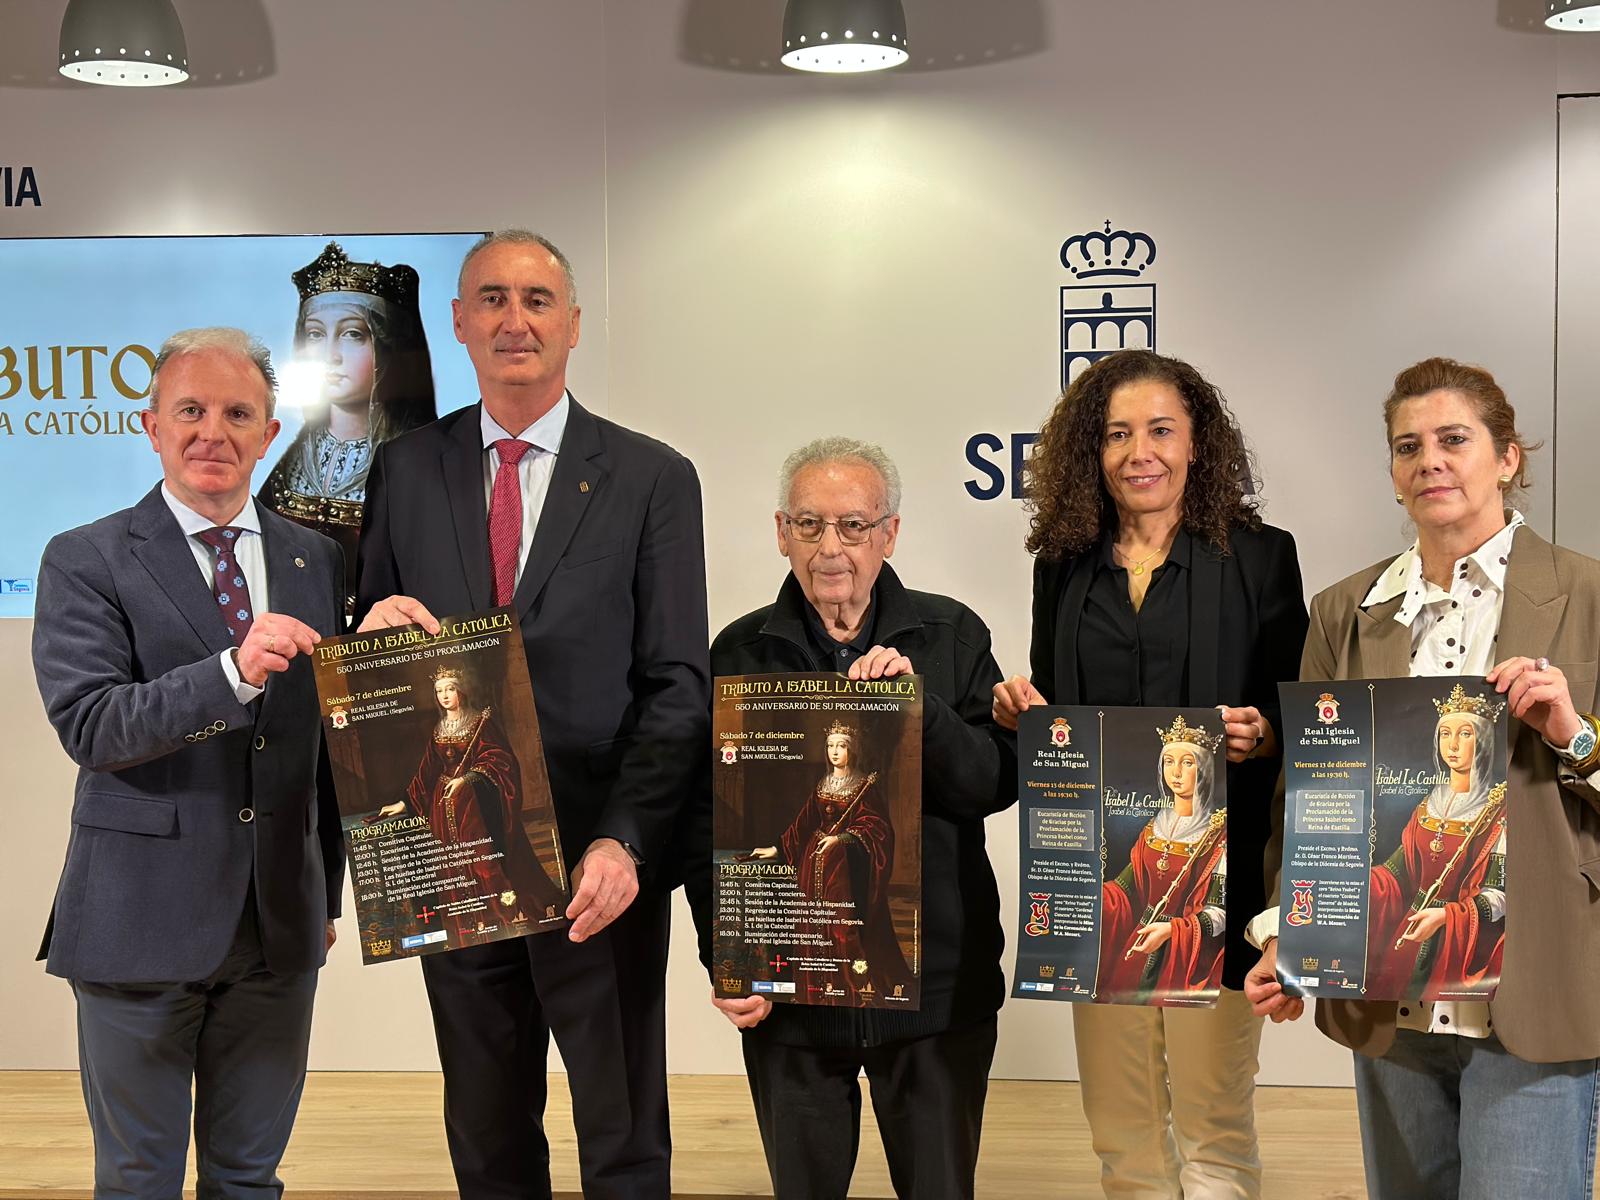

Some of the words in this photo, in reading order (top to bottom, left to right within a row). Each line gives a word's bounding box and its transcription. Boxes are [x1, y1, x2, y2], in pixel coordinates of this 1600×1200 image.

[0, 167, 41, 206] IA
[25, 404, 146, 435] CATÓLIC
[317, 640, 370, 659] TRIBUTO
[373, 638, 382, 650] A
[385, 630, 431, 648] ISABEL
[452, 614, 512, 635] CATÓLICA
[336, 665, 352, 674] 550
[354, 655, 410, 672] ANIVERSARIO
[411, 652, 423, 661] DE
[424, 650, 435, 659] SU
[436, 637, 500, 656] PROCLAMACIÓN
[326, 695, 355, 705] Sábado
[362, 691, 372, 700] de
[373, 685, 412, 697] diciembre
[720, 682, 771, 696] TRIBUTO
[774, 681, 783, 693] A
[787, 680, 832, 692] ISABEL
[835, 680, 852, 692] LA
[856, 681, 915, 694] CATÓLICA
[350, 706, 366, 714] REAL
[366, 702, 389, 711] IGLESIA
[752, 702, 808, 710] ANIVERSARIO
[835, 702, 899, 711] PROCLAMACIÓN
[352, 713, 364, 721] SAN
[365, 710, 389, 719] MIGUEL
[720, 732, 748, 740] Sábado
[1326, 728, 1355, 736] Iglesia
[1330, 737, 1360, 746] Miguel
[1057, 751, 1084, 759] Iglesia
[1061, 761, 1089, 769] Miguel
[1376, 768, 1403, 785] Isabel
[1402, 768, 1410, 785] I
[1417, 771, 1450, 785] Castilla
[1104, 790, 1130, 806] Isabel
[1130, 792, 1137, 807] I
[1143, 794, 1174, 808] Castilla
[350, 816, 429, 839] PROGRAMACIÓN:
[353, 844, 367, 852] 11:45
[378, 838, 405, 847] Comitiva
[405, 832, 433, 843] Capitular.
[720, 864, 797, 876] PROGRAMACIÓN:
